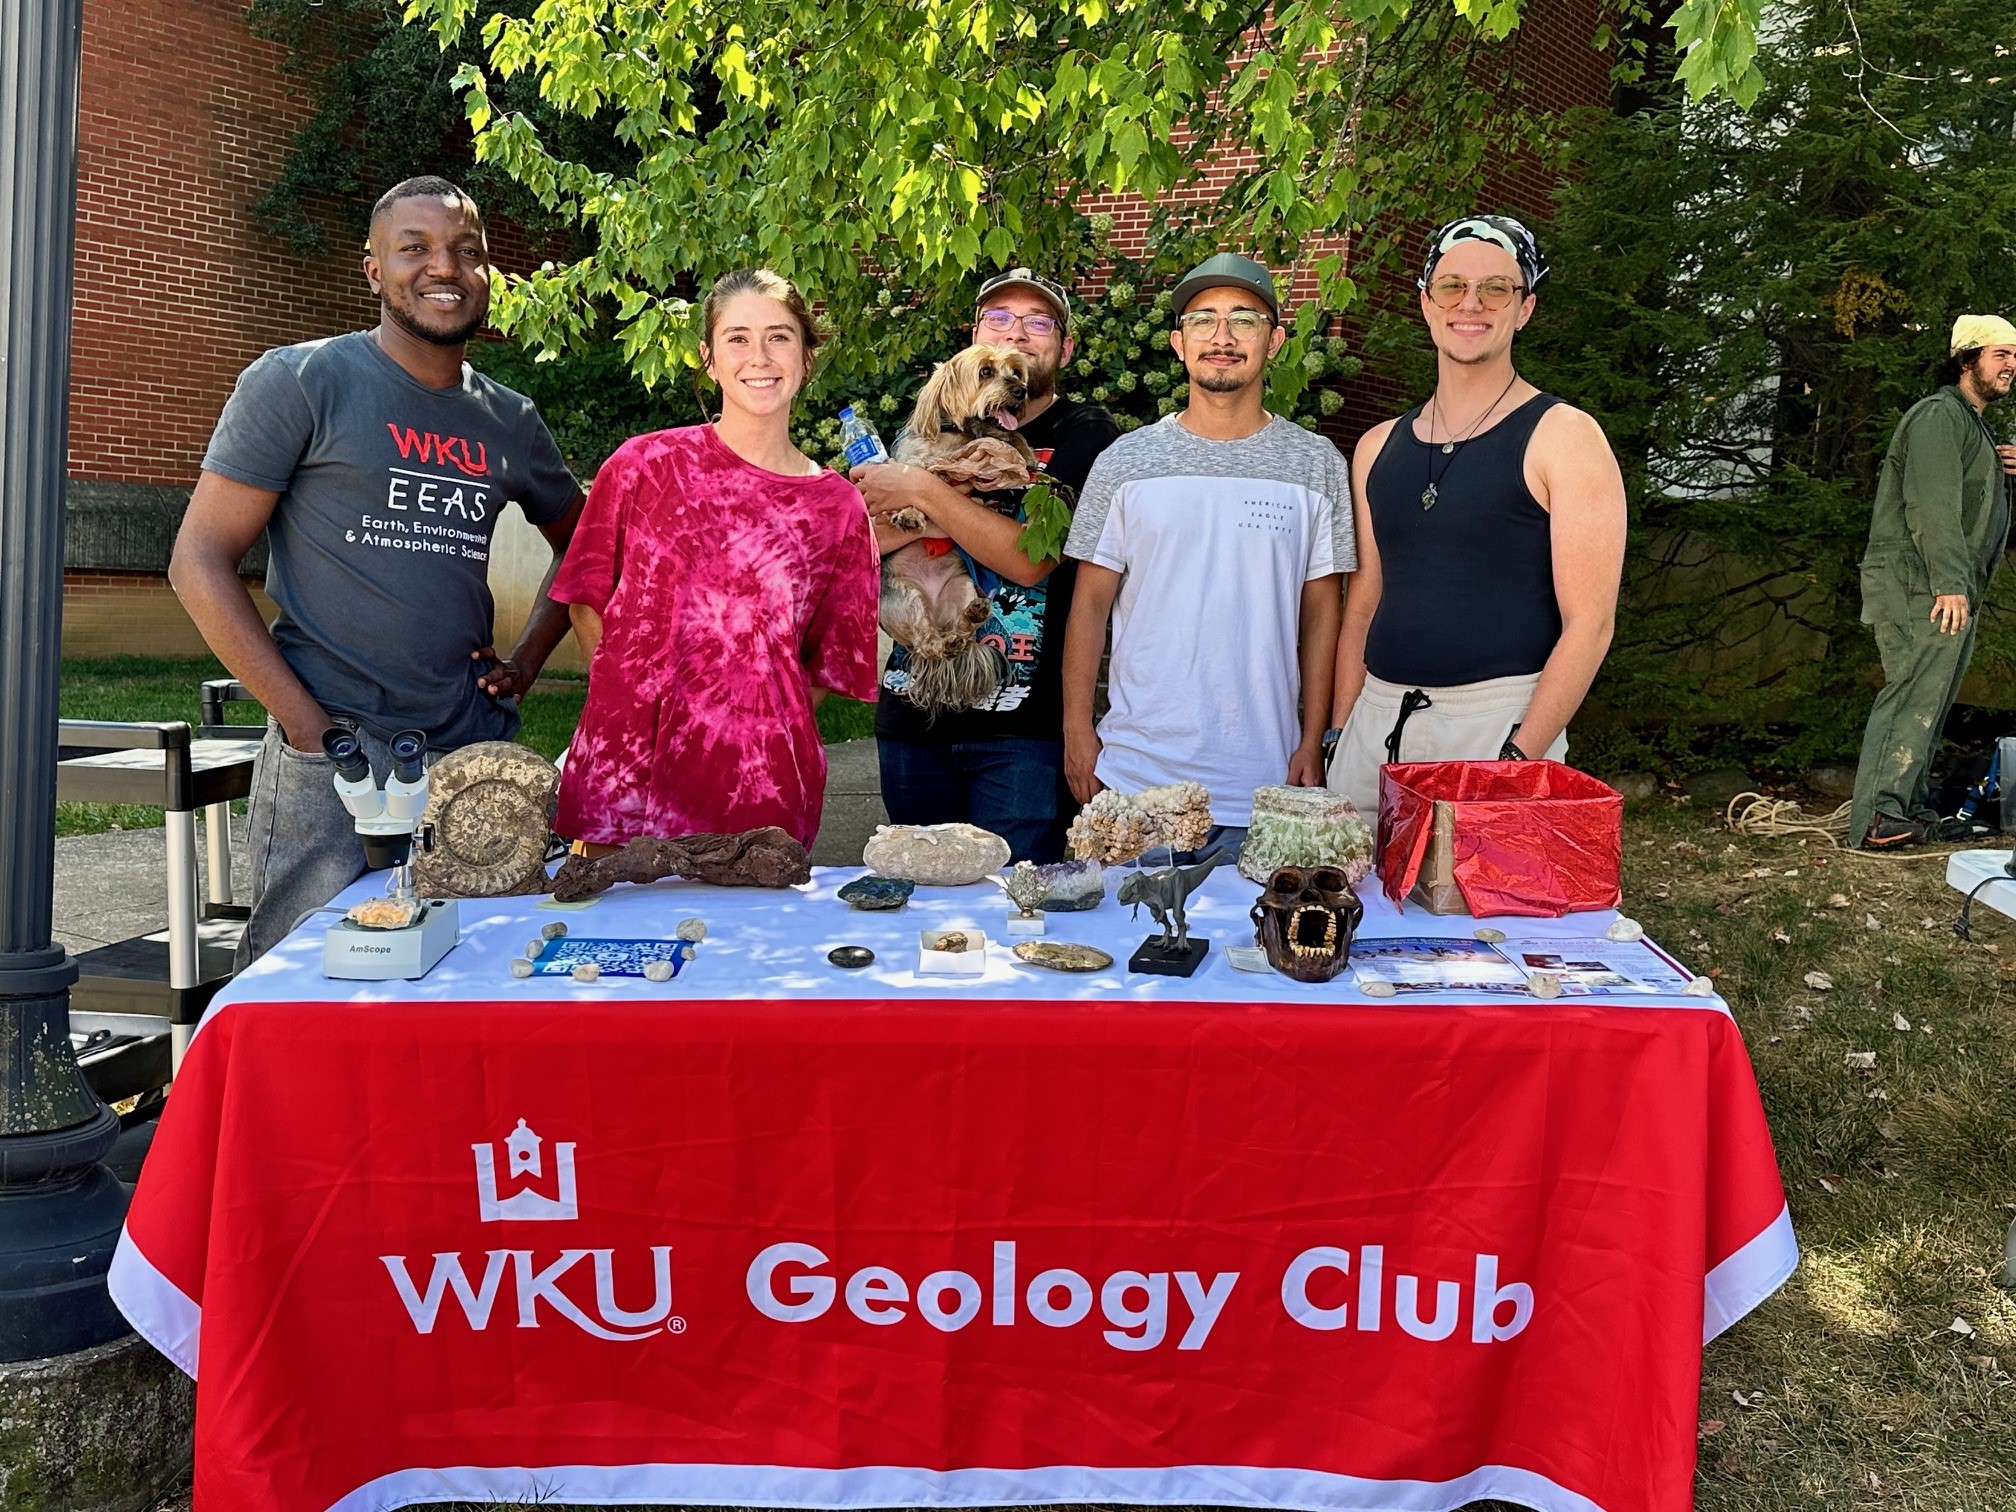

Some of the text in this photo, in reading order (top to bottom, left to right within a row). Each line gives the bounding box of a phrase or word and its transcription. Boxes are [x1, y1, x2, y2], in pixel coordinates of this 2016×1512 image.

[387, 422, 488, 477] WKU
[388, 477, 487, 522] EEAS
[1244, 500, 1293, 510] AMERICAN
[361, 514, 410, 534] Earth,
[1251, 511, 1284, 521] EAGLE
[345, 529, 356, 542] &
[361, 531, 456, 555] Atmospheric
[349, 945, 392, 954] AmScope
[378, 1240, 1534, 1351] WKU Geology Club
